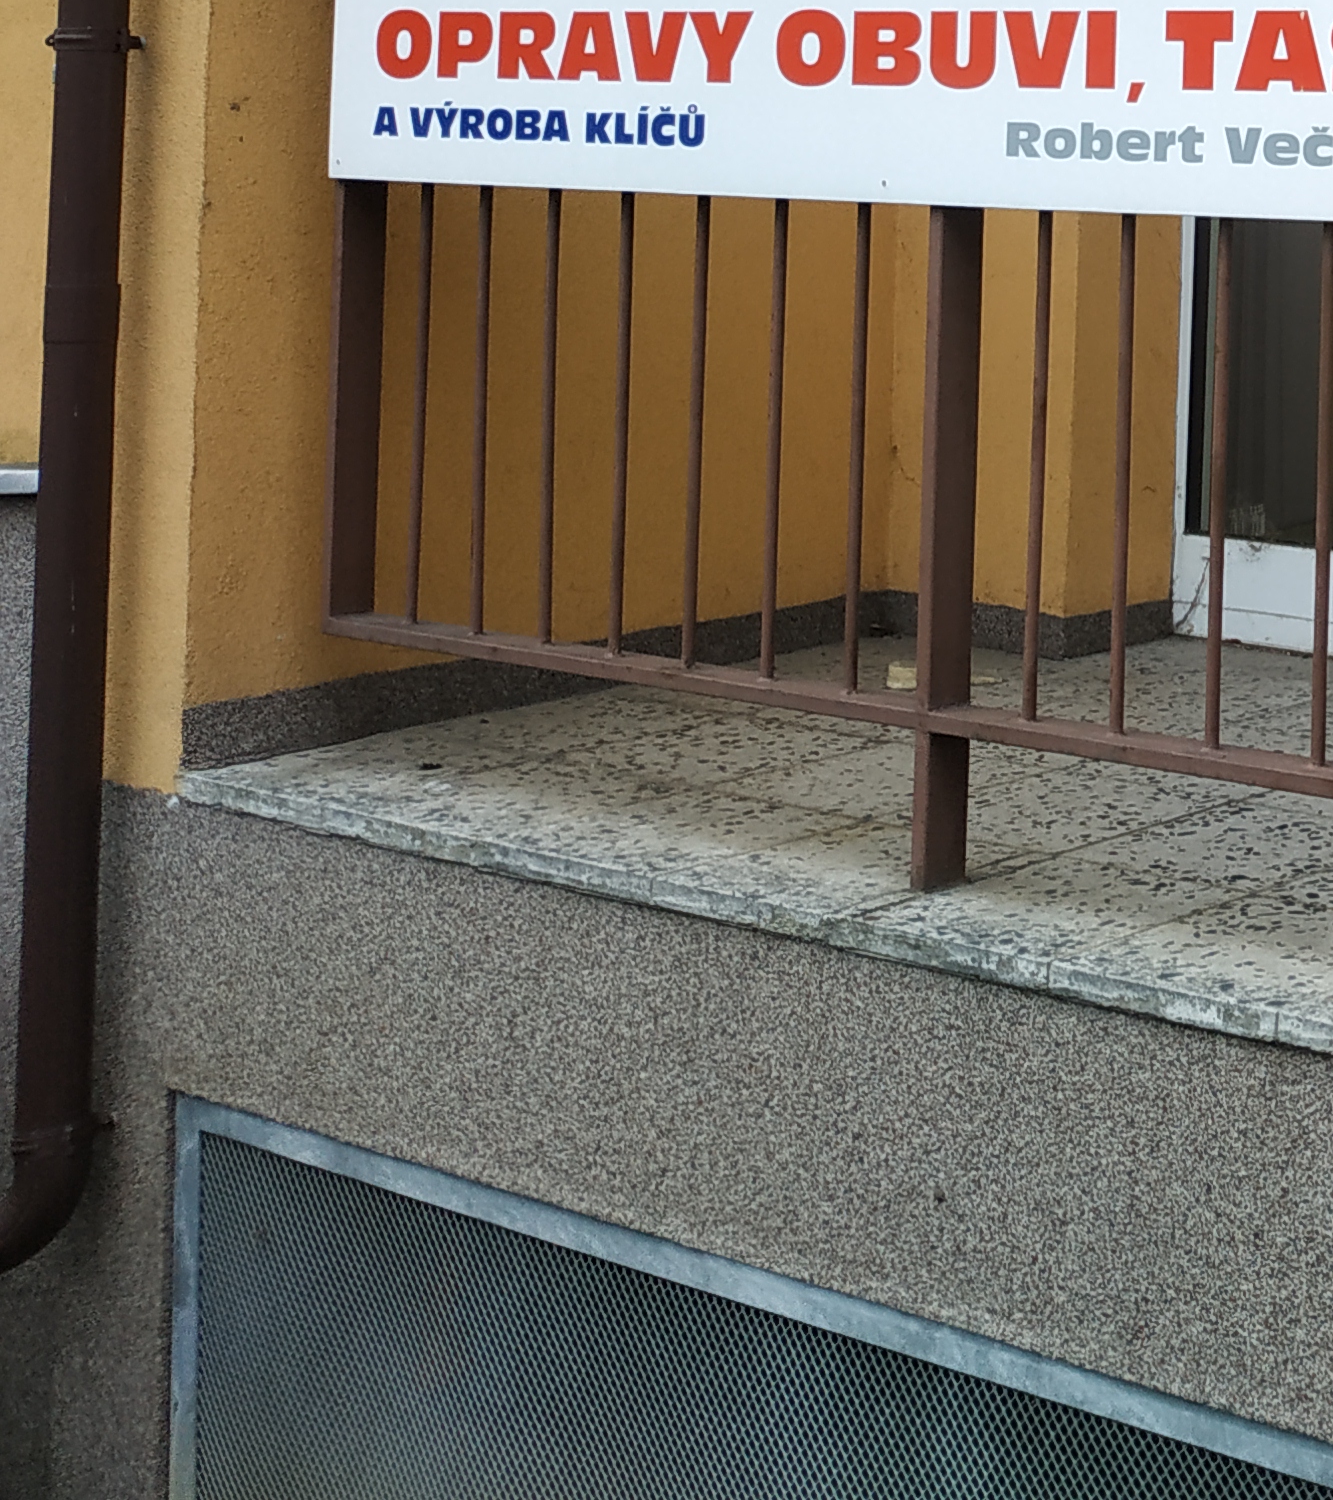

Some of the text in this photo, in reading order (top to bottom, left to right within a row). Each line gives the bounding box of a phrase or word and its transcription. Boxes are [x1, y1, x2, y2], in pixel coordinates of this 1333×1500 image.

[375, 9, 754, 83] OPRAVY
[776, 9, 1145, 103] OBUVI,
[373, 100, 706, 148] A VÝROBA KLÍČŮ
[1005, 121, 1205, 164] Robert
